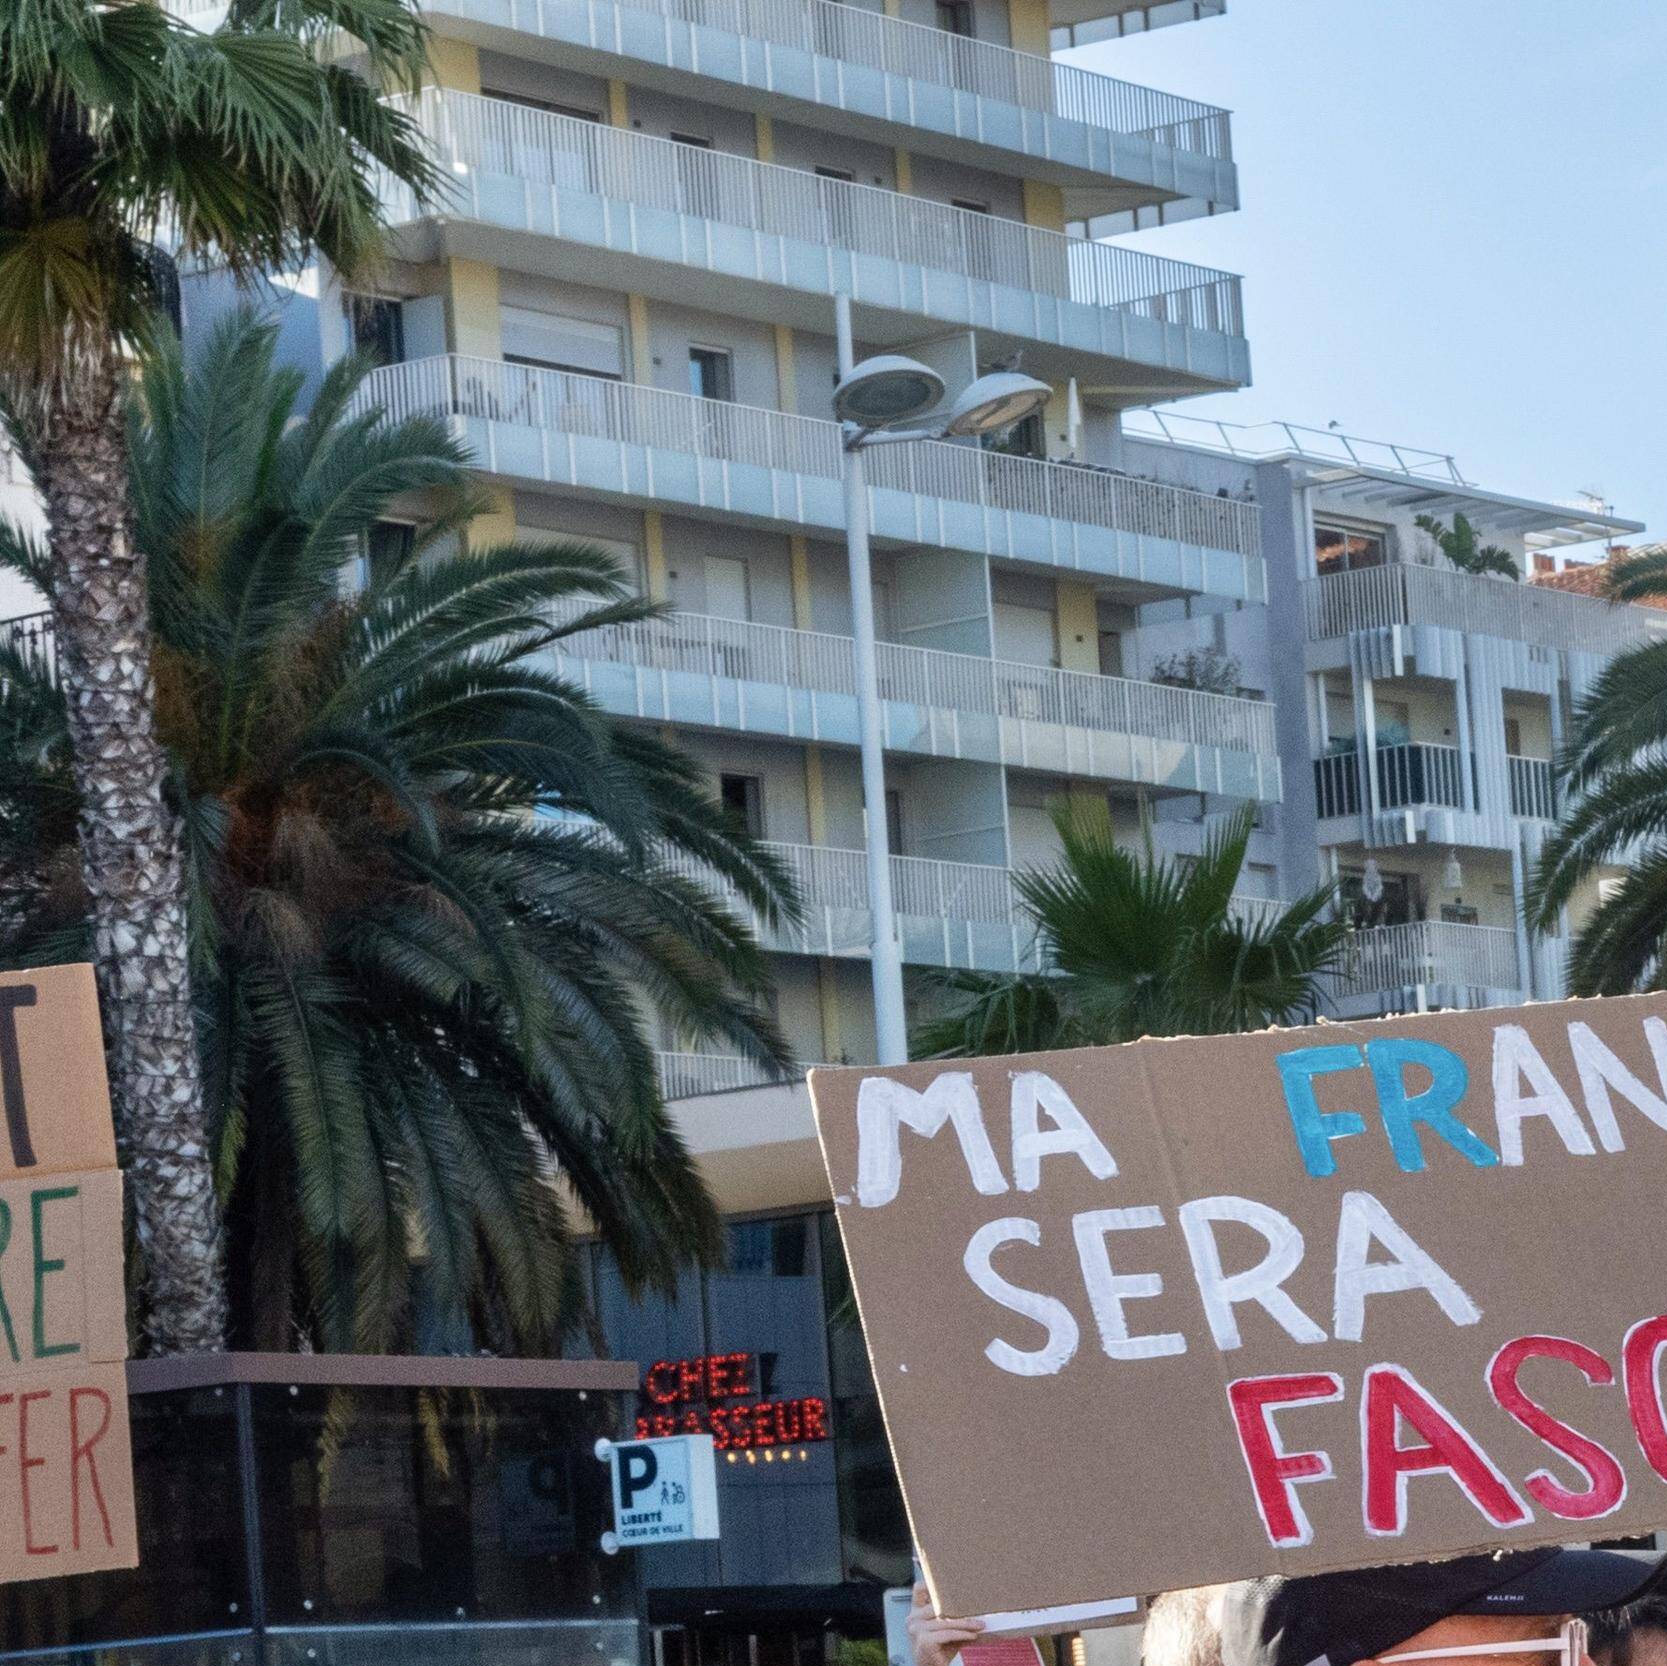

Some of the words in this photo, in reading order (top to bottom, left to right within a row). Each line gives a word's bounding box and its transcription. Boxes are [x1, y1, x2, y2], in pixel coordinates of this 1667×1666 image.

[857, 1070, 1120, 1208] MA
[962, 1190, 1482, 1376] SERA
[645, 1352, 750, 1404] CHEZ
[617, 1444, 659, 1509] P
[620, 1509, 663, 1526] LIBERTÉ
